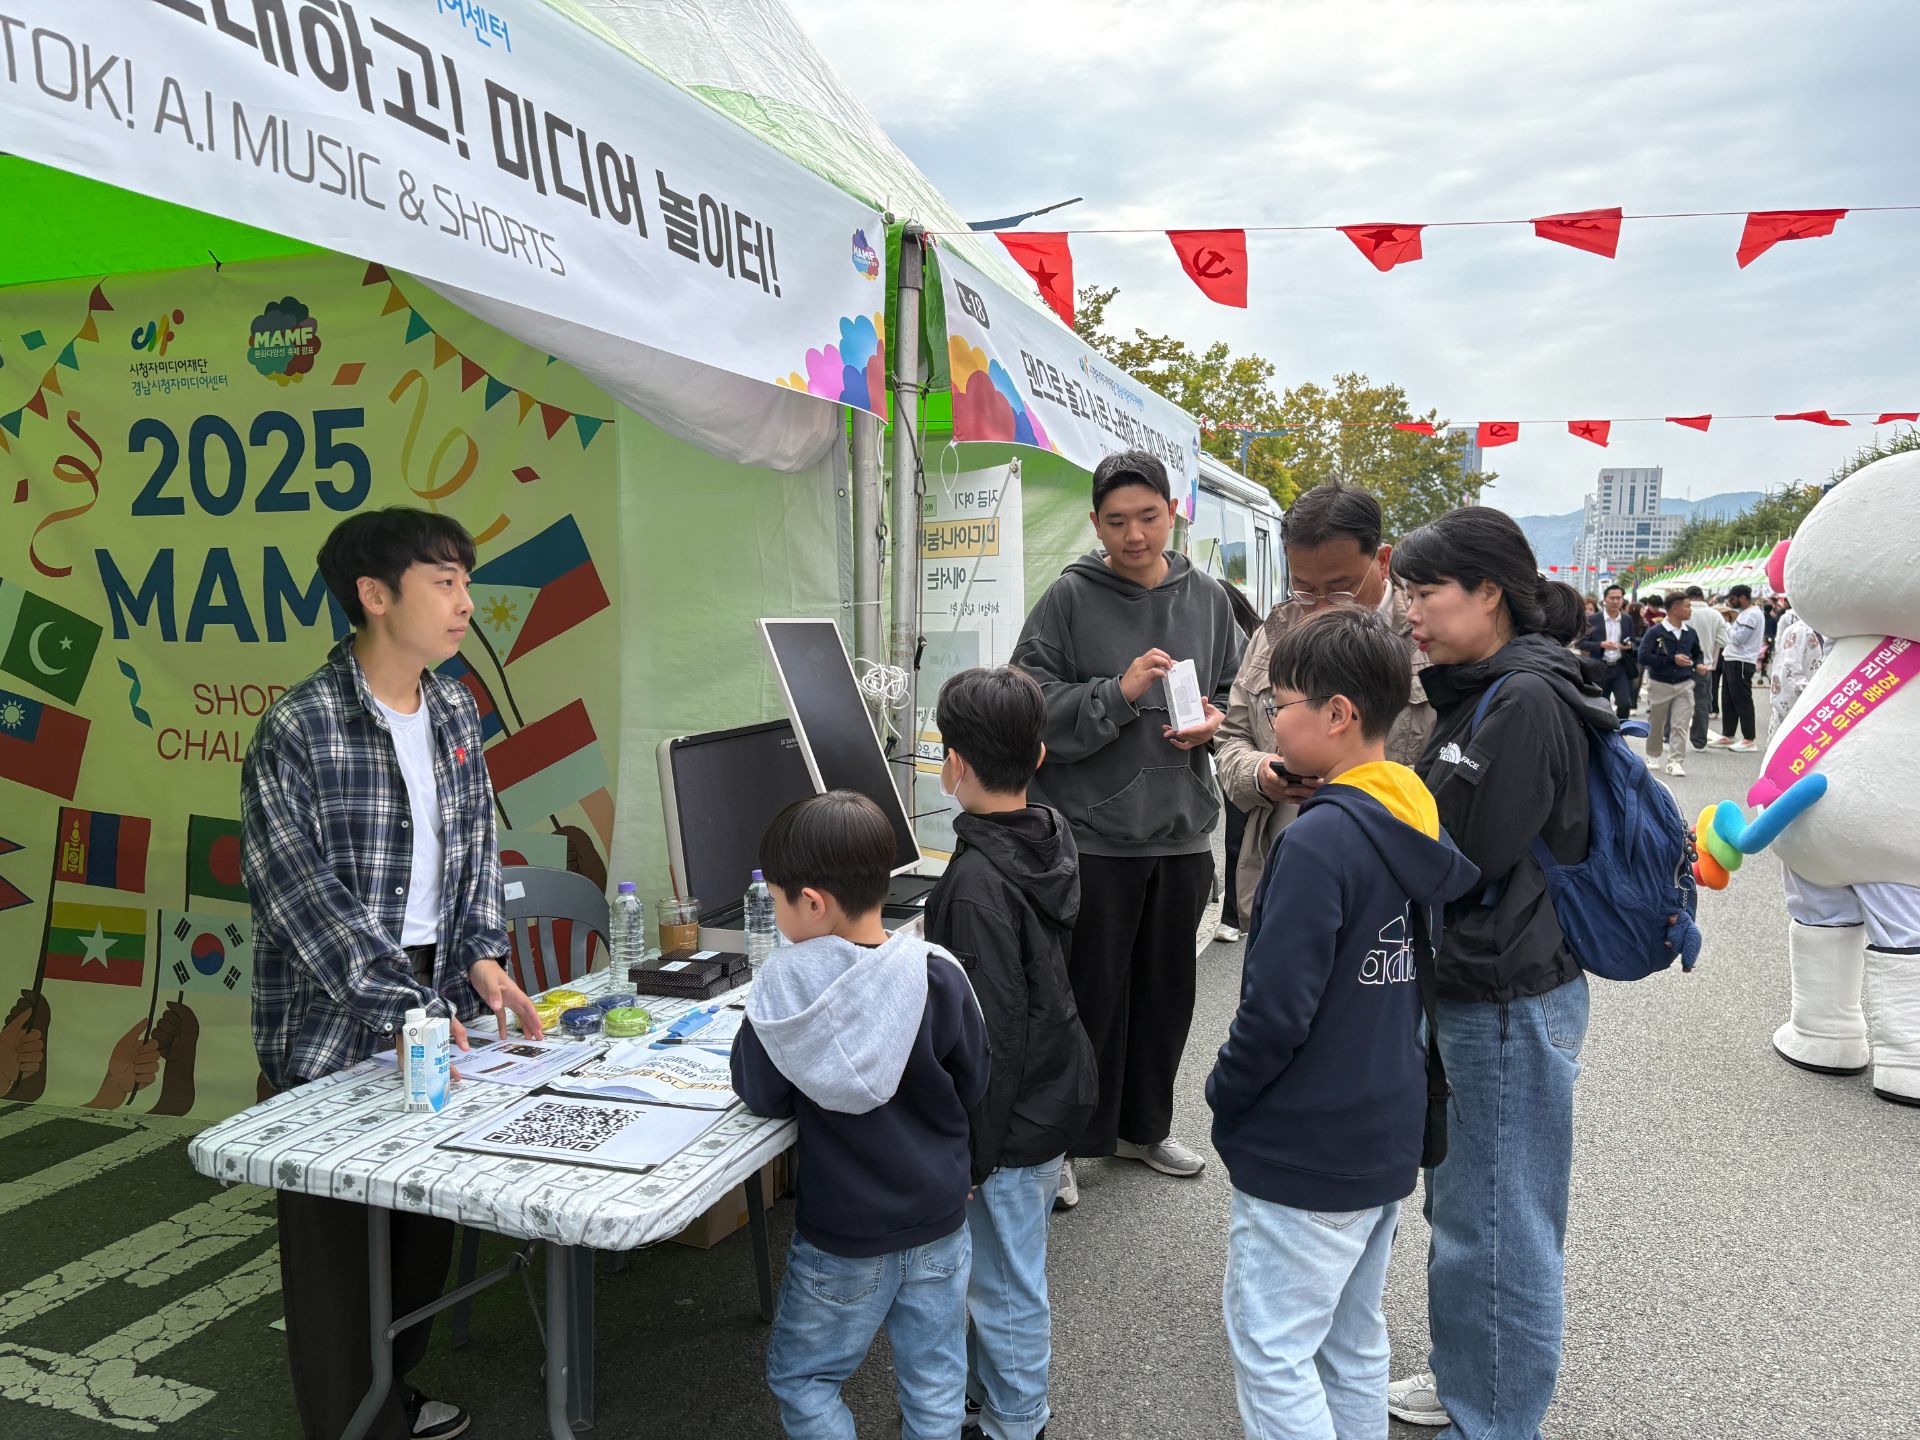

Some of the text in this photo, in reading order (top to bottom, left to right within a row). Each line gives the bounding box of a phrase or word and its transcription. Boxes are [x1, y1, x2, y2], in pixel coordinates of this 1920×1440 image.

[233, 101, 386, 210] MUSIC
[399, 169, 428, 225] &
[433, 184, 567, 277] SHORTS
[484, 78, 649, 240] 미디어
[655, 168, 782, 299] 놀이터!
[255, 326, 313, 349] MAMF
[130, 358, 208, 378] 시청자미디어재단
[131, 375, 228, 396] 경남시청자미디어센터
[1020, 350, 1067, 408] 댄스로
[1062, 373, 1091, 420] 놀고
[128, 407, 372, 516] 2025
[94, 546, 352, 643] MAM
[193, 683, 296, 717] SHO
[1789, 671, 1900, 775] 경품 받아 가세요
[1802, 678, 1863, 735] 참여하고
[157, 728, 245, 763] CHAL
[1461, 755, 1480, 770] FACE
